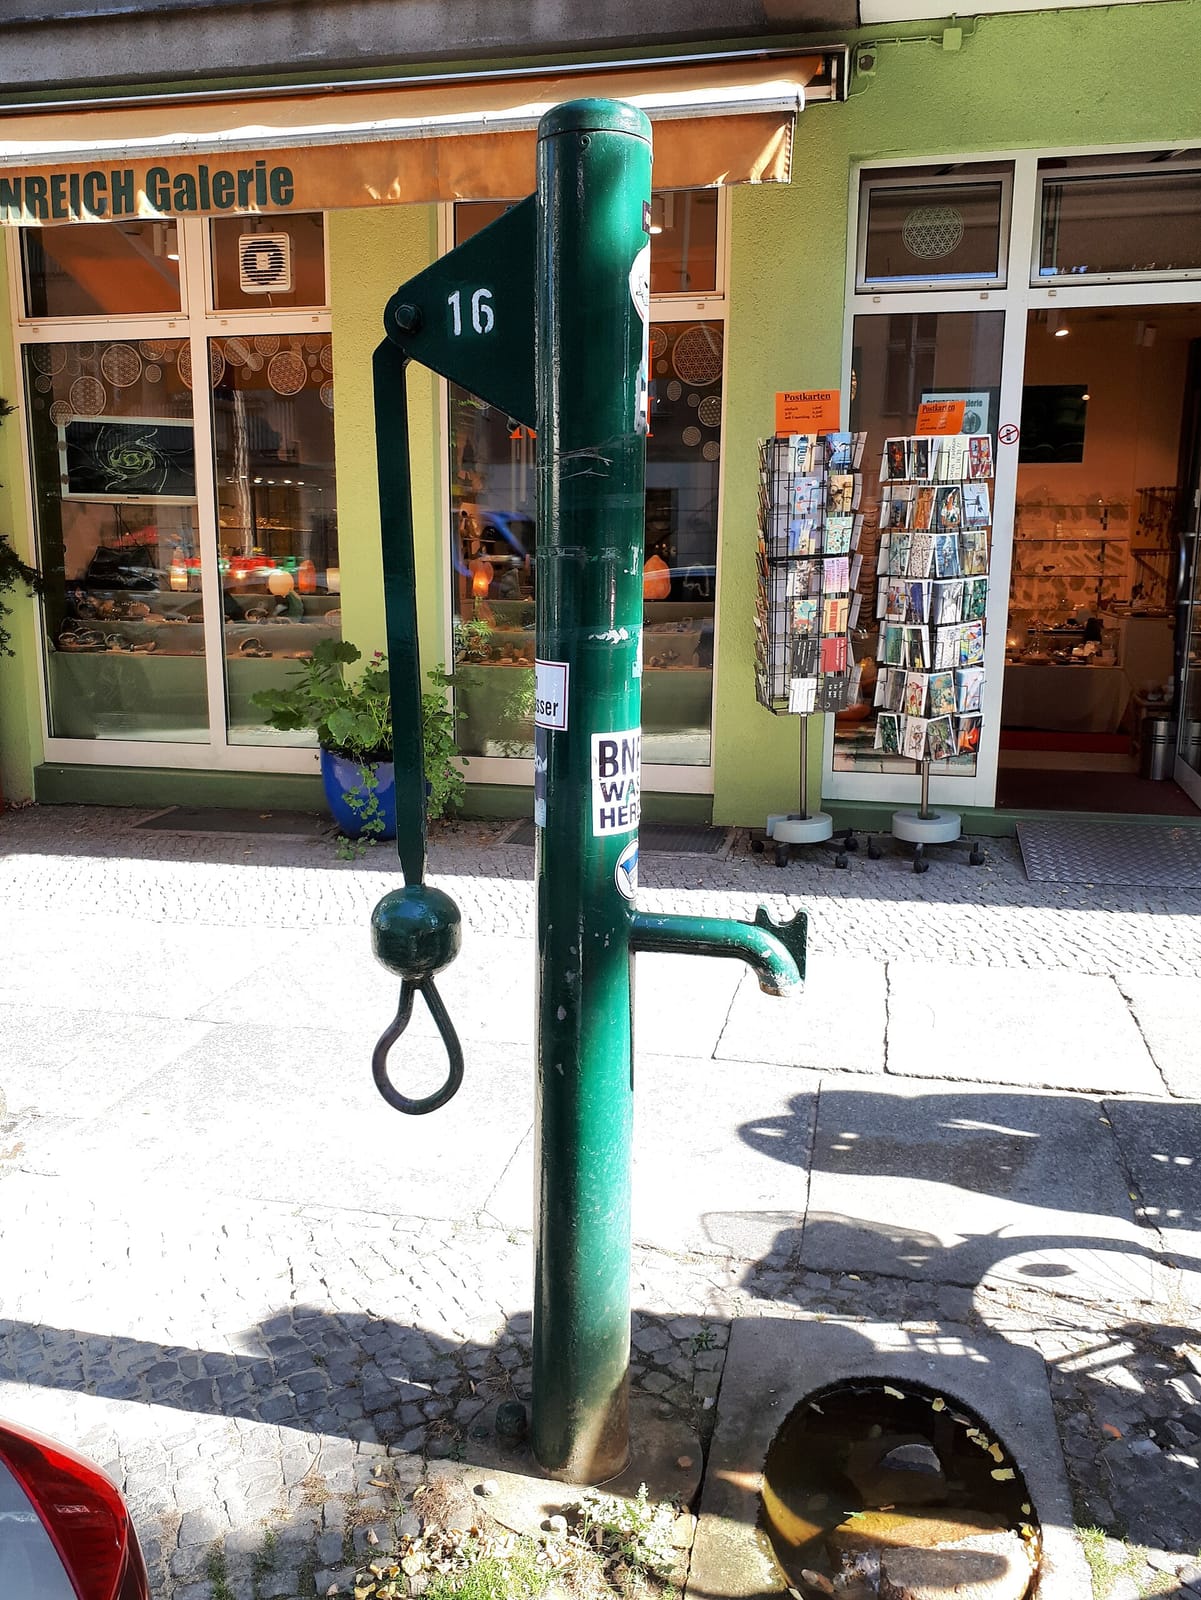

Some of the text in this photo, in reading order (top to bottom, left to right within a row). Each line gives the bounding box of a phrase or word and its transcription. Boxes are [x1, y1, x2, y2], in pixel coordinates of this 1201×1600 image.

[145, 160, 294, 212] Galerie
[448, 288, 494, 336] 16
[784, 392, 831, 401] Postkarten
[535, 698, 558, 716] sser
